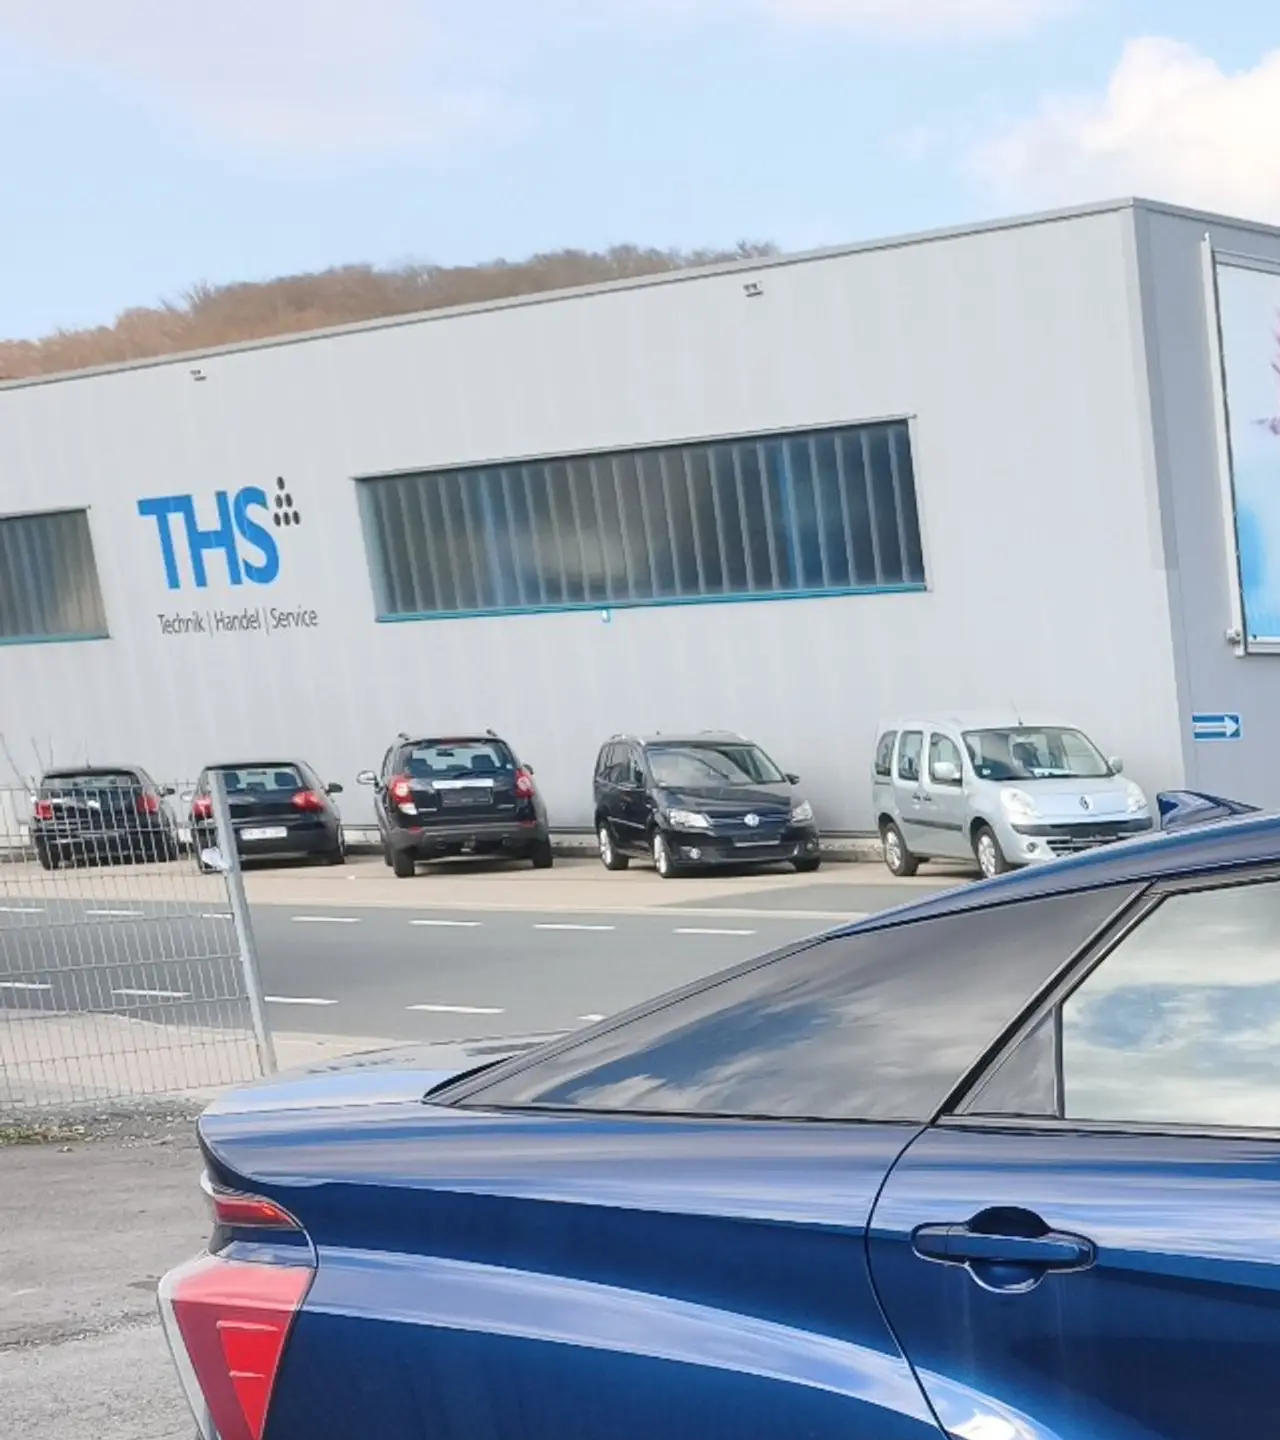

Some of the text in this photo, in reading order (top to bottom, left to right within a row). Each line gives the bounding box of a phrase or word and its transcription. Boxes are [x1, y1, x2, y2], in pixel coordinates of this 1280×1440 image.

[137, 486, 279, 590] THS
[157, 604, 320, 635] Technik Handel Service
